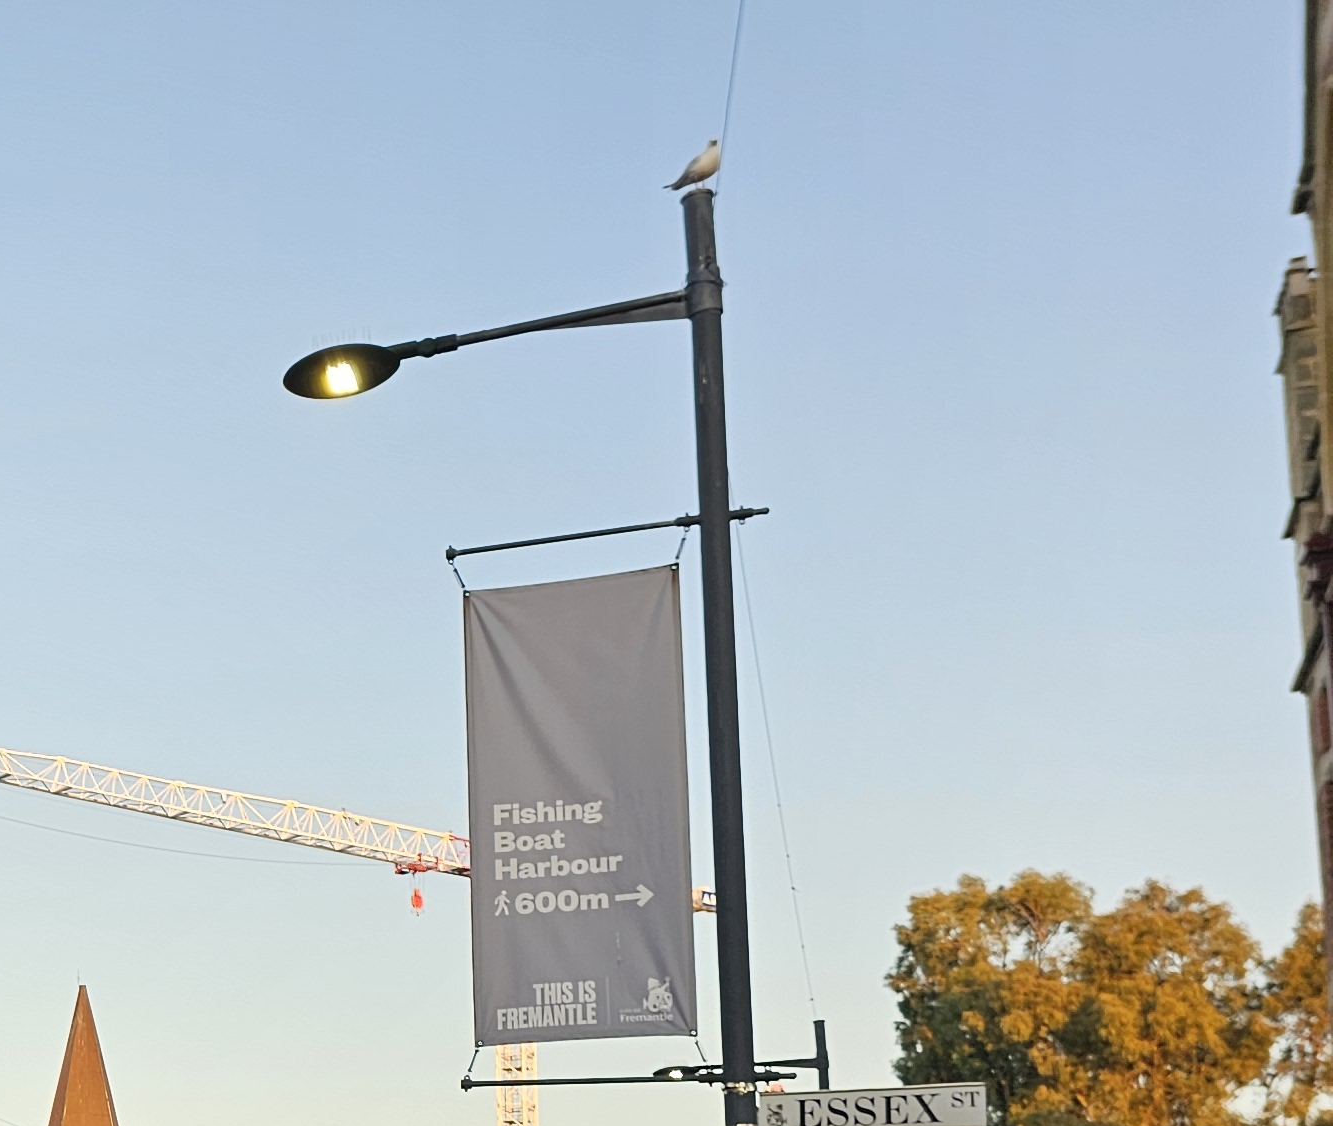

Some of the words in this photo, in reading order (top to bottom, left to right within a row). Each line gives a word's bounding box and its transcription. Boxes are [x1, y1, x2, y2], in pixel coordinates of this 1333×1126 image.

[494, 800, 603, 825] Fishing
[494, 830, 565, 853] Boat
[495, 855, 623, 880] Harbour
[515, 890, 609, 914] 600m
[533, 982, 574, 1006] THIS
[578, 980, 596, 1003] IS
[497, 1003, 597, 1030] FREMANTLE
[620, 1013, 674, 1022] Fremantle
[952, 1091, 980, 1108] ST
